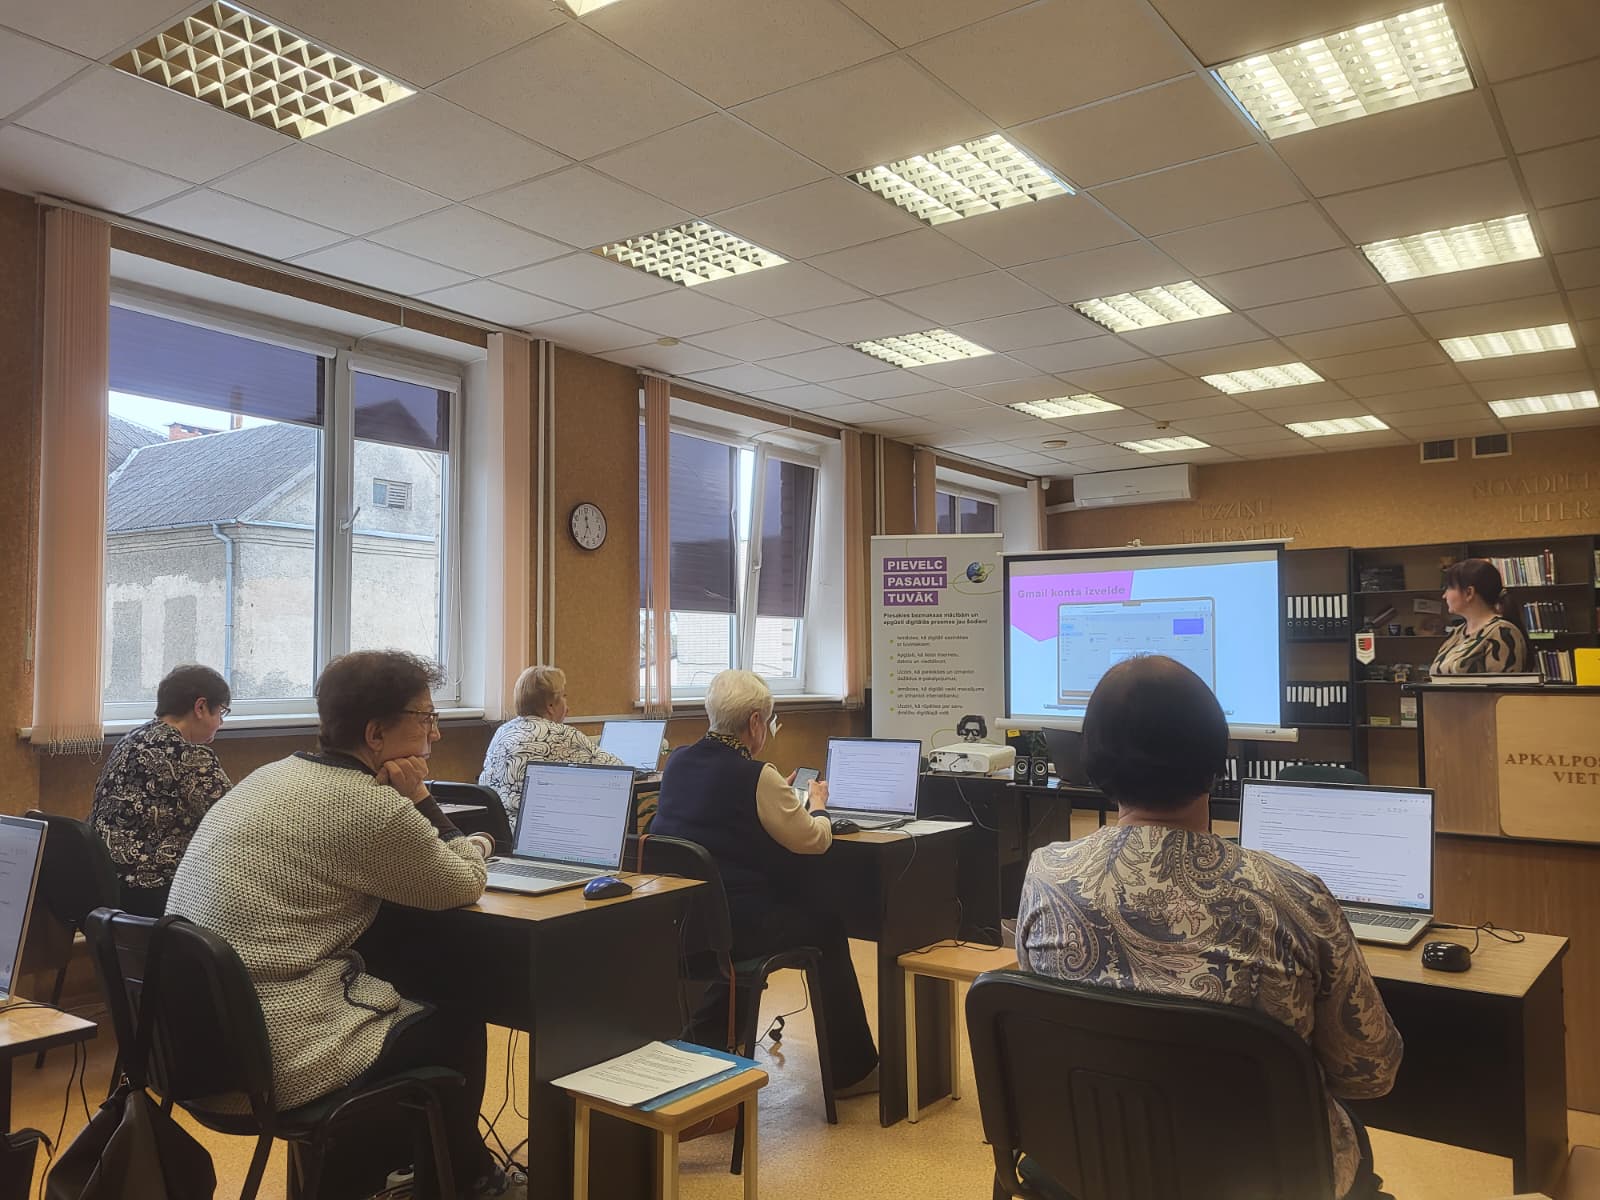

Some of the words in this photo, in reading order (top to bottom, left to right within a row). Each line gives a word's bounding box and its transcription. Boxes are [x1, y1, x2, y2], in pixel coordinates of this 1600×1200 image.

[887, 560, 943, 570] PIEVELC
[887, 577, 943, 587] PASAULI
[887, 592, 934, 603] TUVĀK
[1018, 589, 1048, 598] Gmail
[1051, 588, 1081, 597] konta
[1504, 753, 1600, 768] APKALPO
[1552, 771, 1600, 785] VIET
